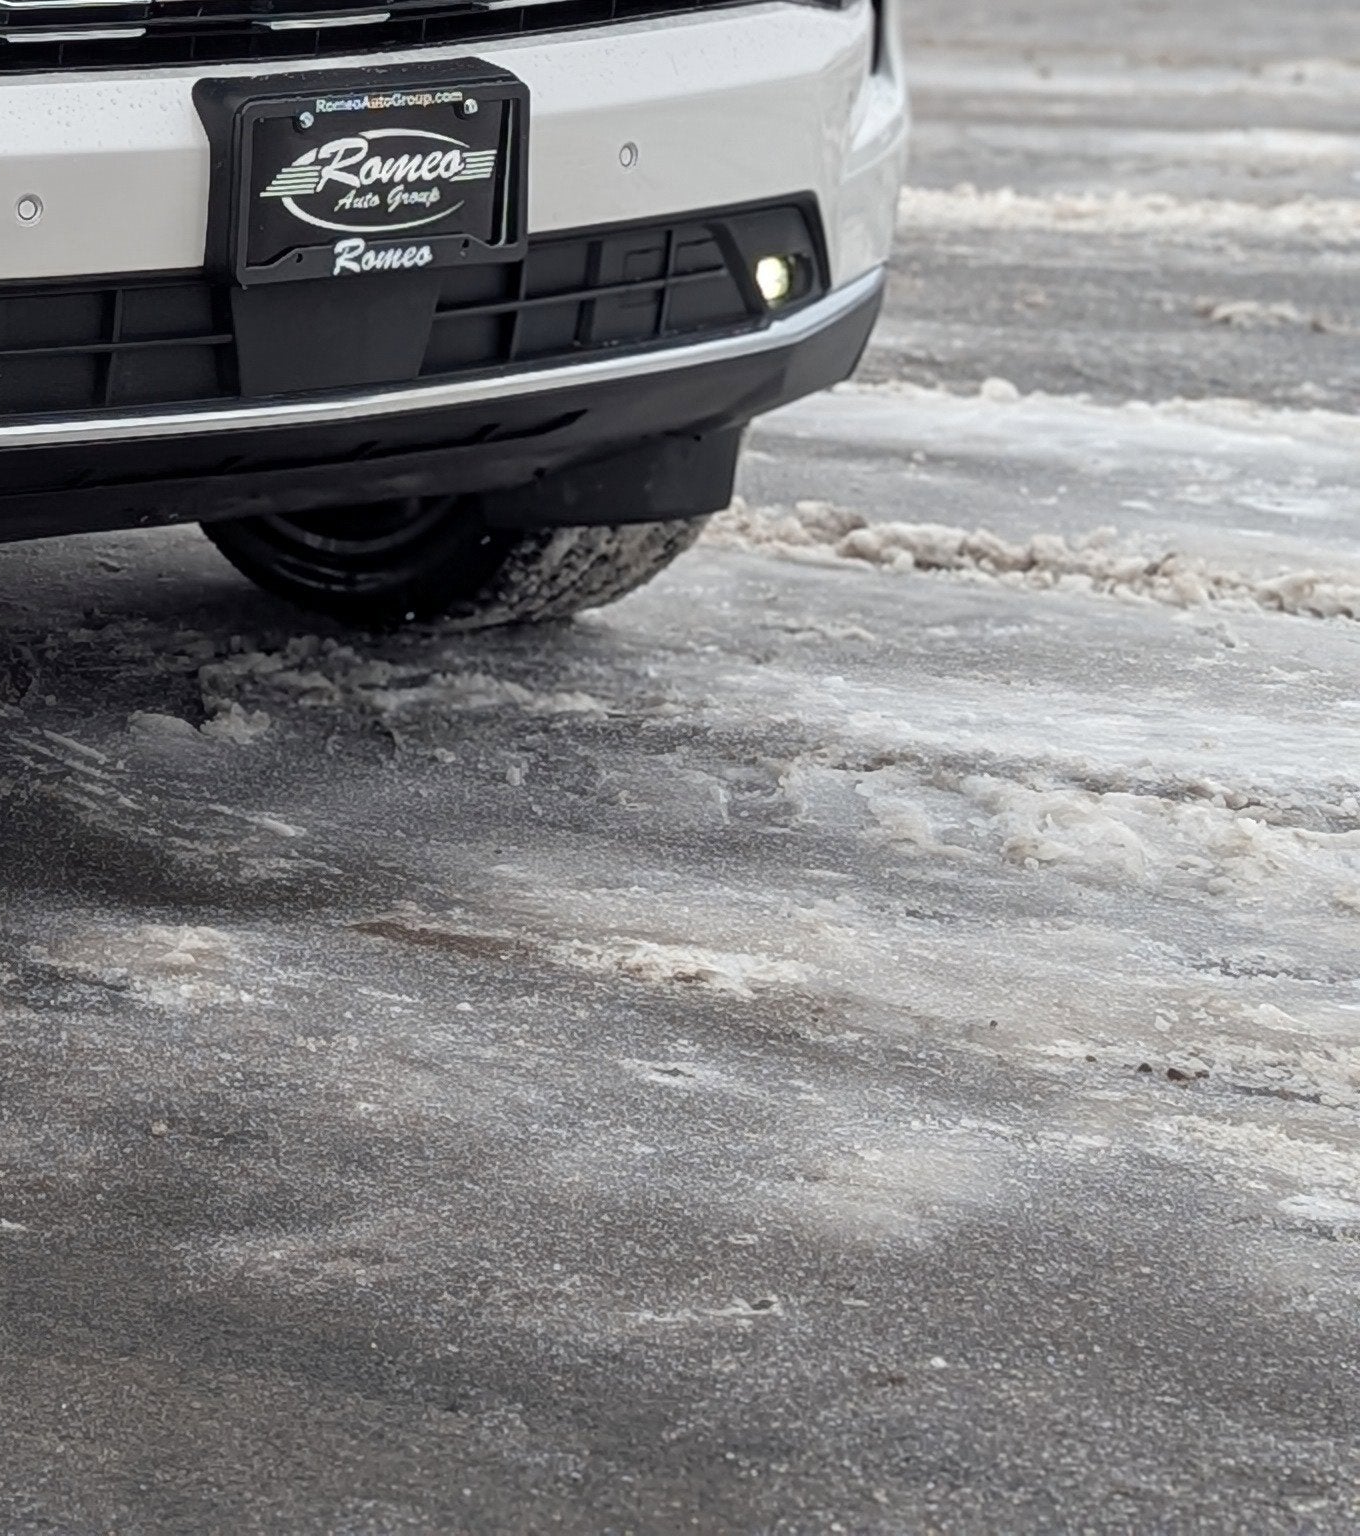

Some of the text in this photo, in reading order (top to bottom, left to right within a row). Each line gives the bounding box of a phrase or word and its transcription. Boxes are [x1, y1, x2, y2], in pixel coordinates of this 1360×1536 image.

[315, 91, 463, 114] RomeoAutoGroup.com
[315, 137, 465, 193] Romeo
[333, 183, 442, 213] Auto Group
[332, 237, 434, 276] Romeo
